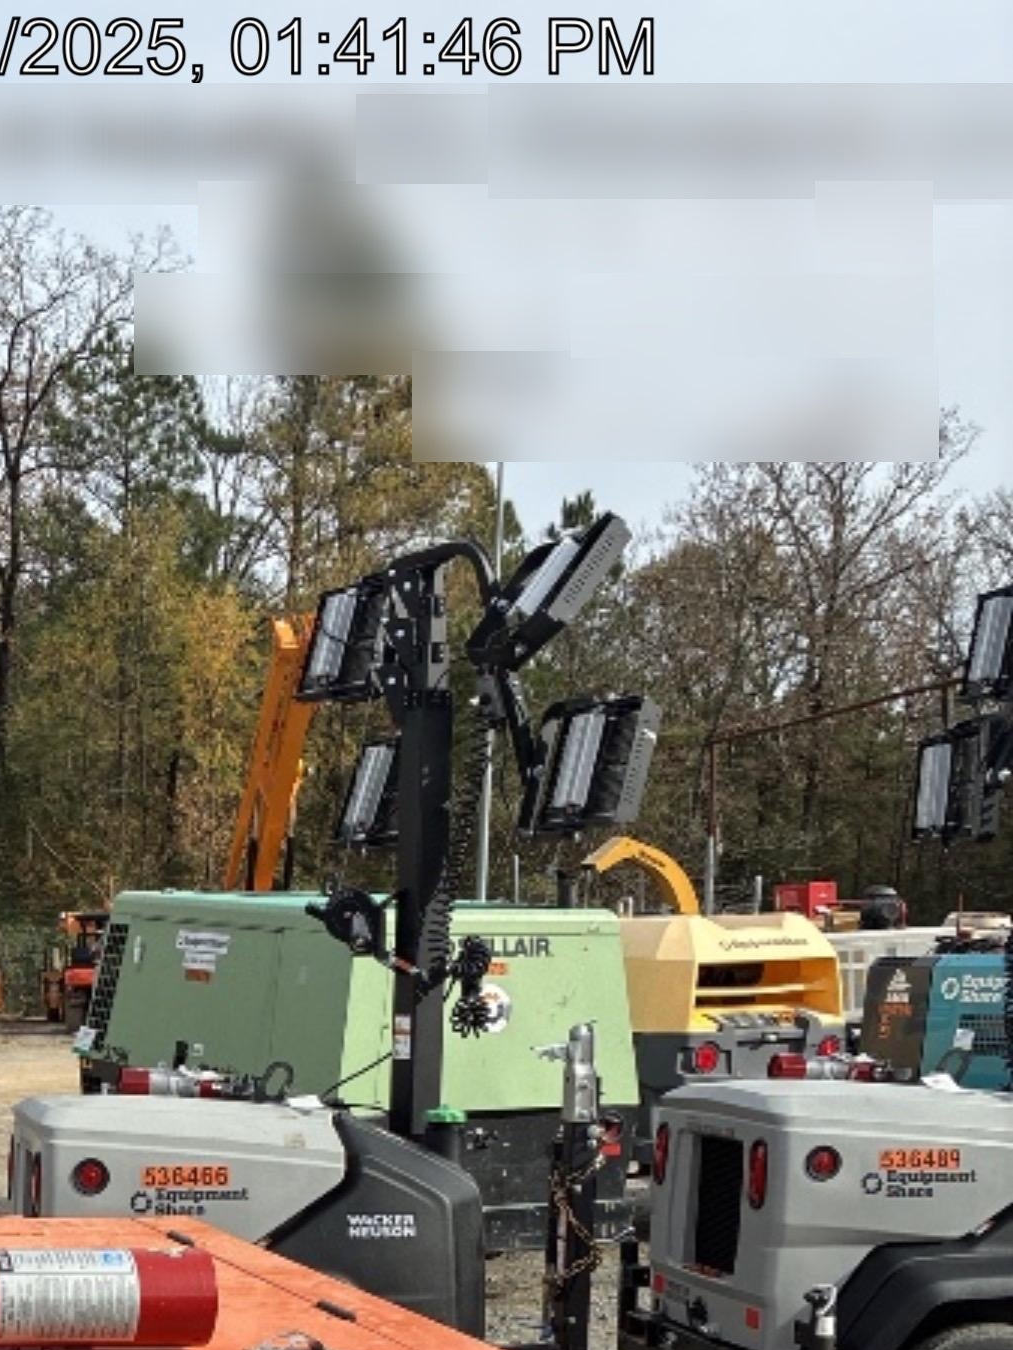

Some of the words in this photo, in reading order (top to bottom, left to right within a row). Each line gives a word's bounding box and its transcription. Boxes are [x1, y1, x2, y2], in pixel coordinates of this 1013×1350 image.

[144, 1165, 229, 1187] 536466
[886, 1168, 977, 1185] Equipment
[154, 1187, 249, 1203] Equipment
[886, 1184, 933, 1198] Share
[346, 1213, 414, 1226] WACKER
[348, 1225, 417, 1239] NEUSON
